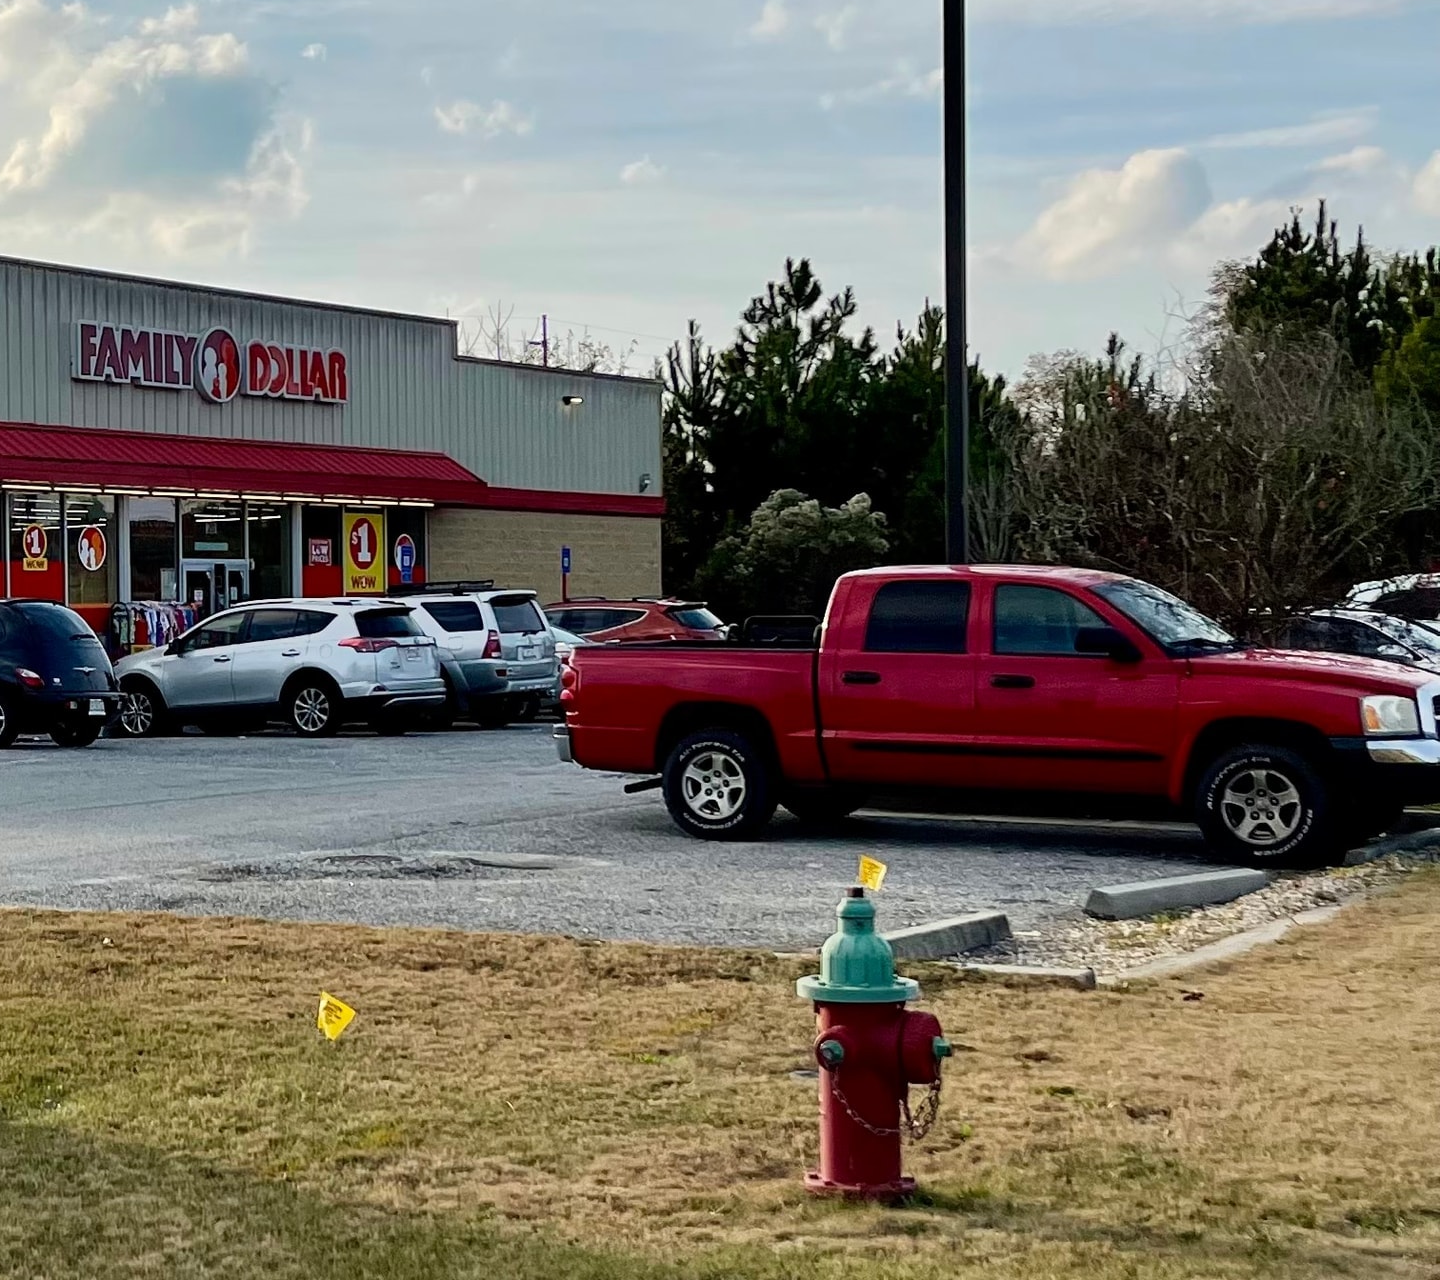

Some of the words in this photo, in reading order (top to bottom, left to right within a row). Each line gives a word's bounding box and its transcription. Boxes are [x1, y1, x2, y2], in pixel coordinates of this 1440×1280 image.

[78, 321, 199, 388] FAMILY
[246, 339, 348, 403] DOLLAR
[350, 522, 372, 562] $1
